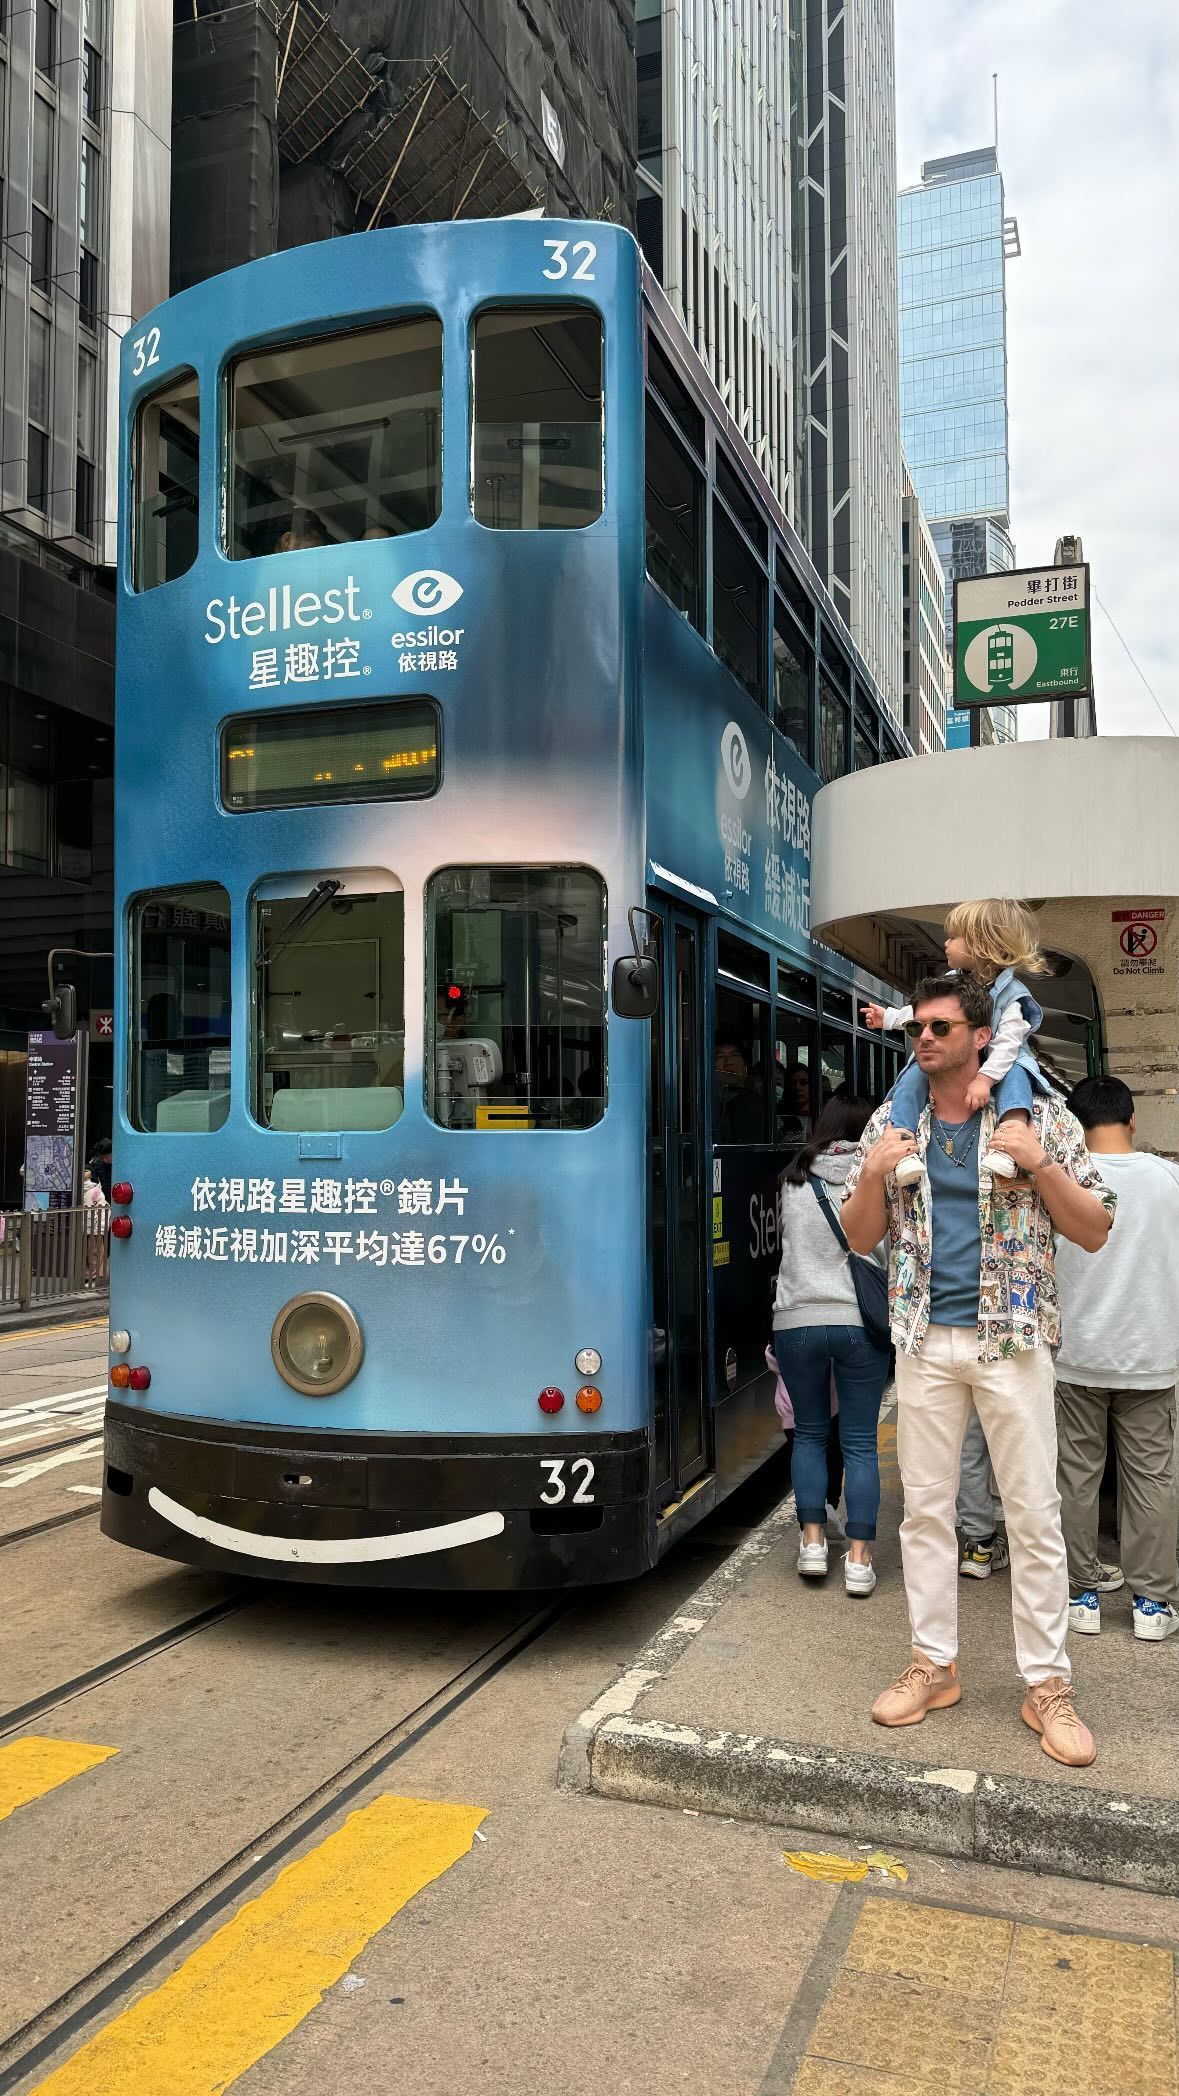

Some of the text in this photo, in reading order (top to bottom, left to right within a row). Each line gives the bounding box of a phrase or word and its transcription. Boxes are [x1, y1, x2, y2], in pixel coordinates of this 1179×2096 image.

[542, 240, 597, 280] 32
[133, 327, 160, 376] 32
[1027, 576, 1078, 594] 畢打街
[1008, 594, 1078, 608] Pedder Street
[1049, 616, 1079, 630] 27E
[391, 626, 465, 649] essilor
[398, 650, 458, 672] 依視路
[1060, 667, 1079, 677] 東行
[1036, 678, 1079, 688] Eastbound
[764, 755, 810, 863] 依視路
[720, 813, 752, 857] essilor
[724, 849, 750, 896] 依視路
[1131, 911, 1165, 919] DANGER
[1126, 967, 1140, 975] Not
[1142, 966, 1164, 974] Climb
[539, 1458, 595, 1505] 32
